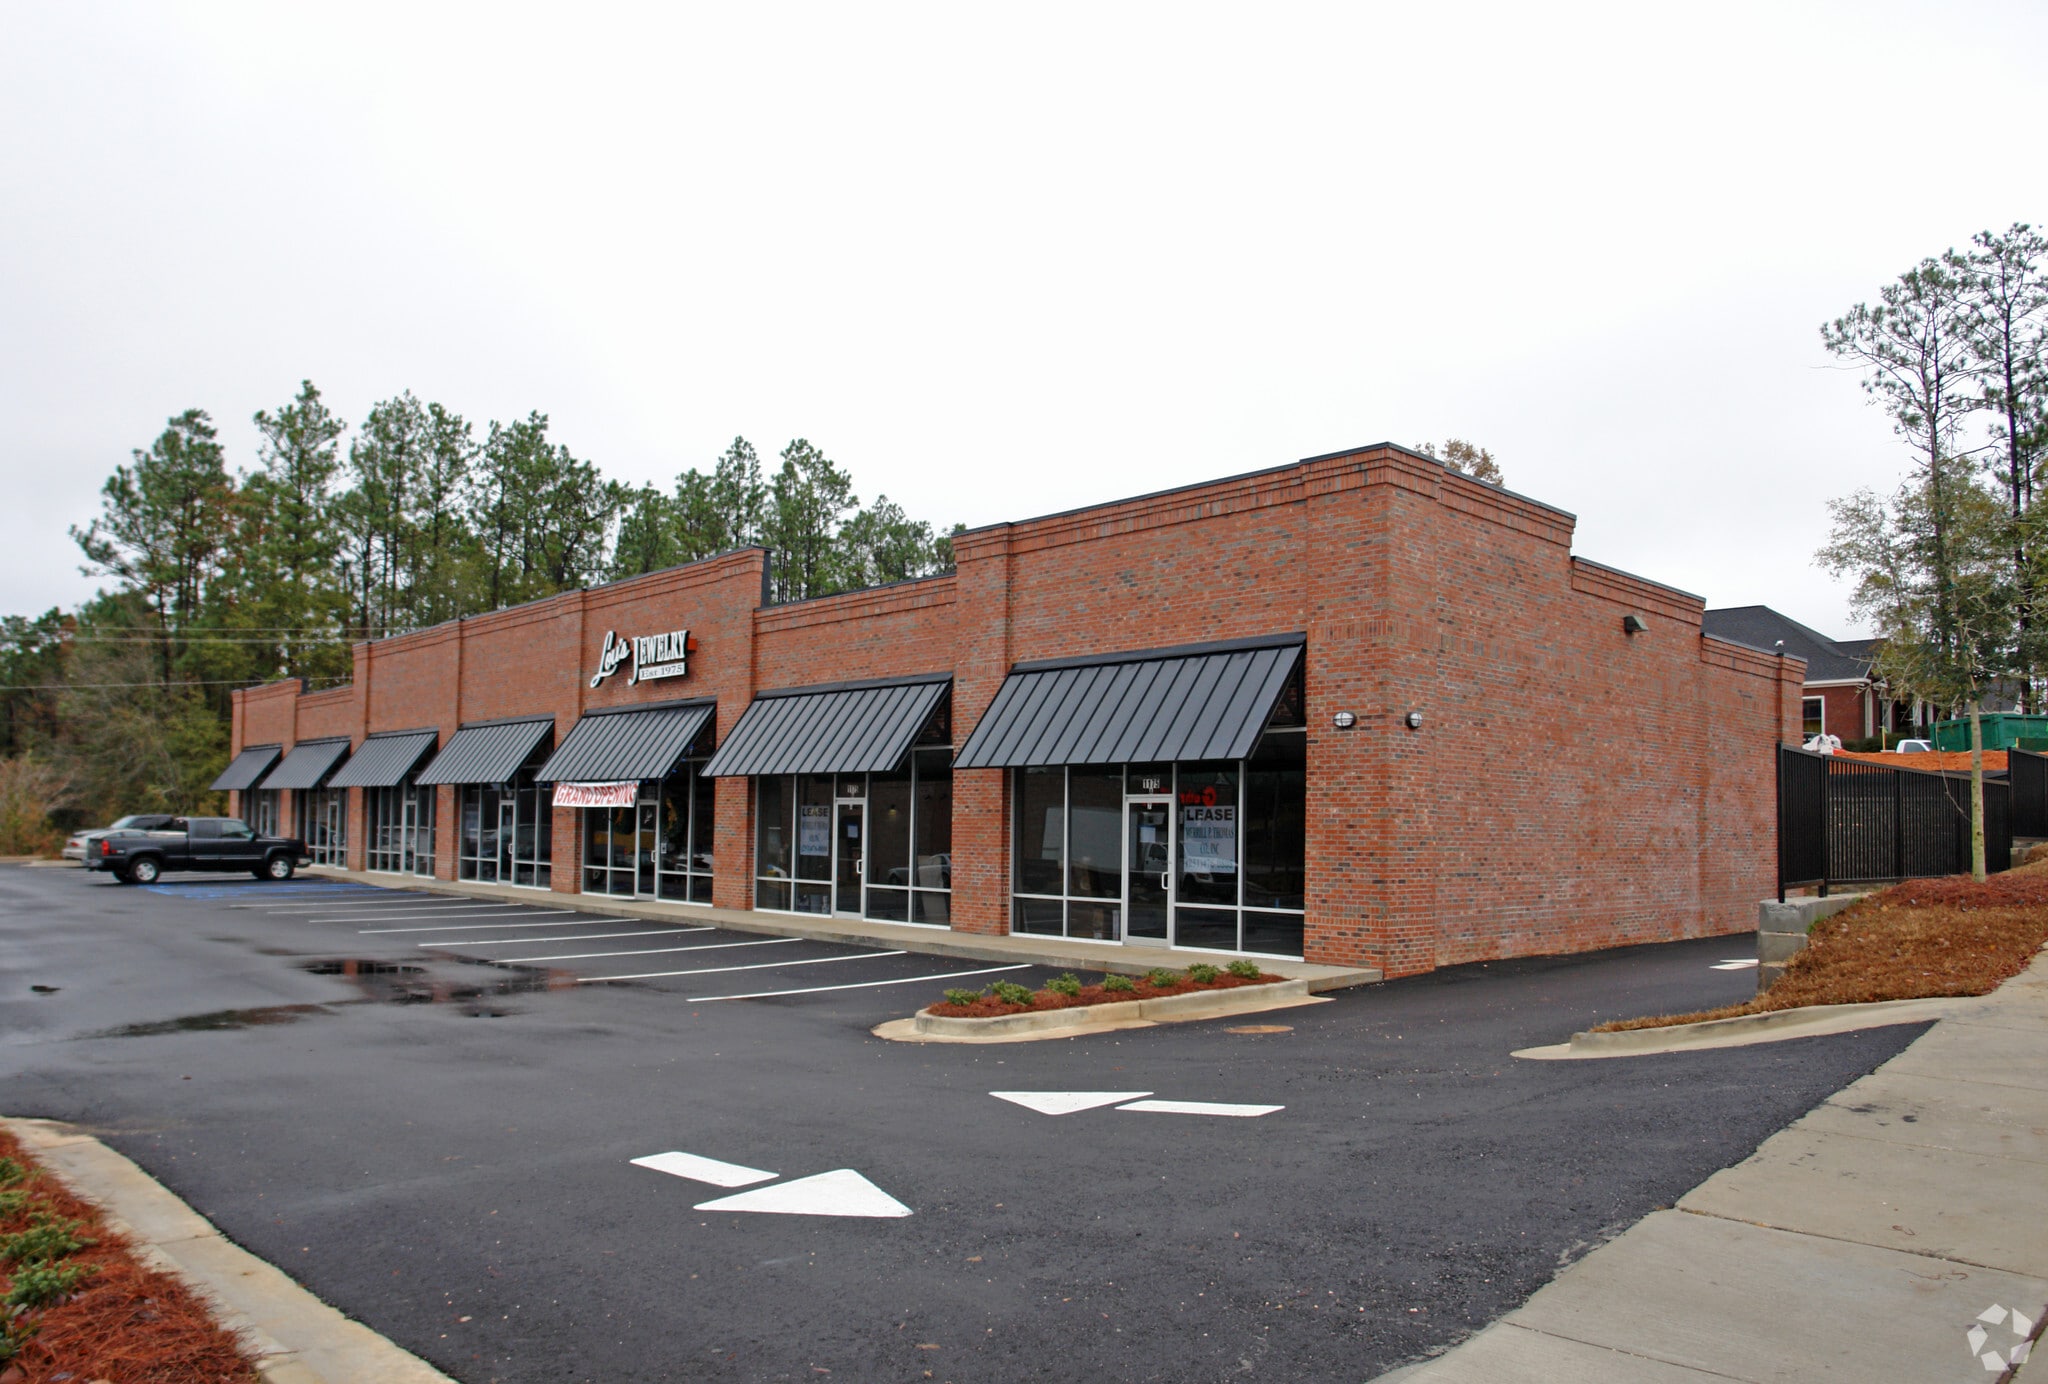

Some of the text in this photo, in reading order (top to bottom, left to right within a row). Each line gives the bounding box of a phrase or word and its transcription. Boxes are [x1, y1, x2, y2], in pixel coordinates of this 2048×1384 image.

[627, 630, 688, 686] JEWELRY
[557, 783, 638, 805] GRAND OPENING
[802, 807, 828, 817] LEASE
[1186, 808, 1233, 821] LEASE
